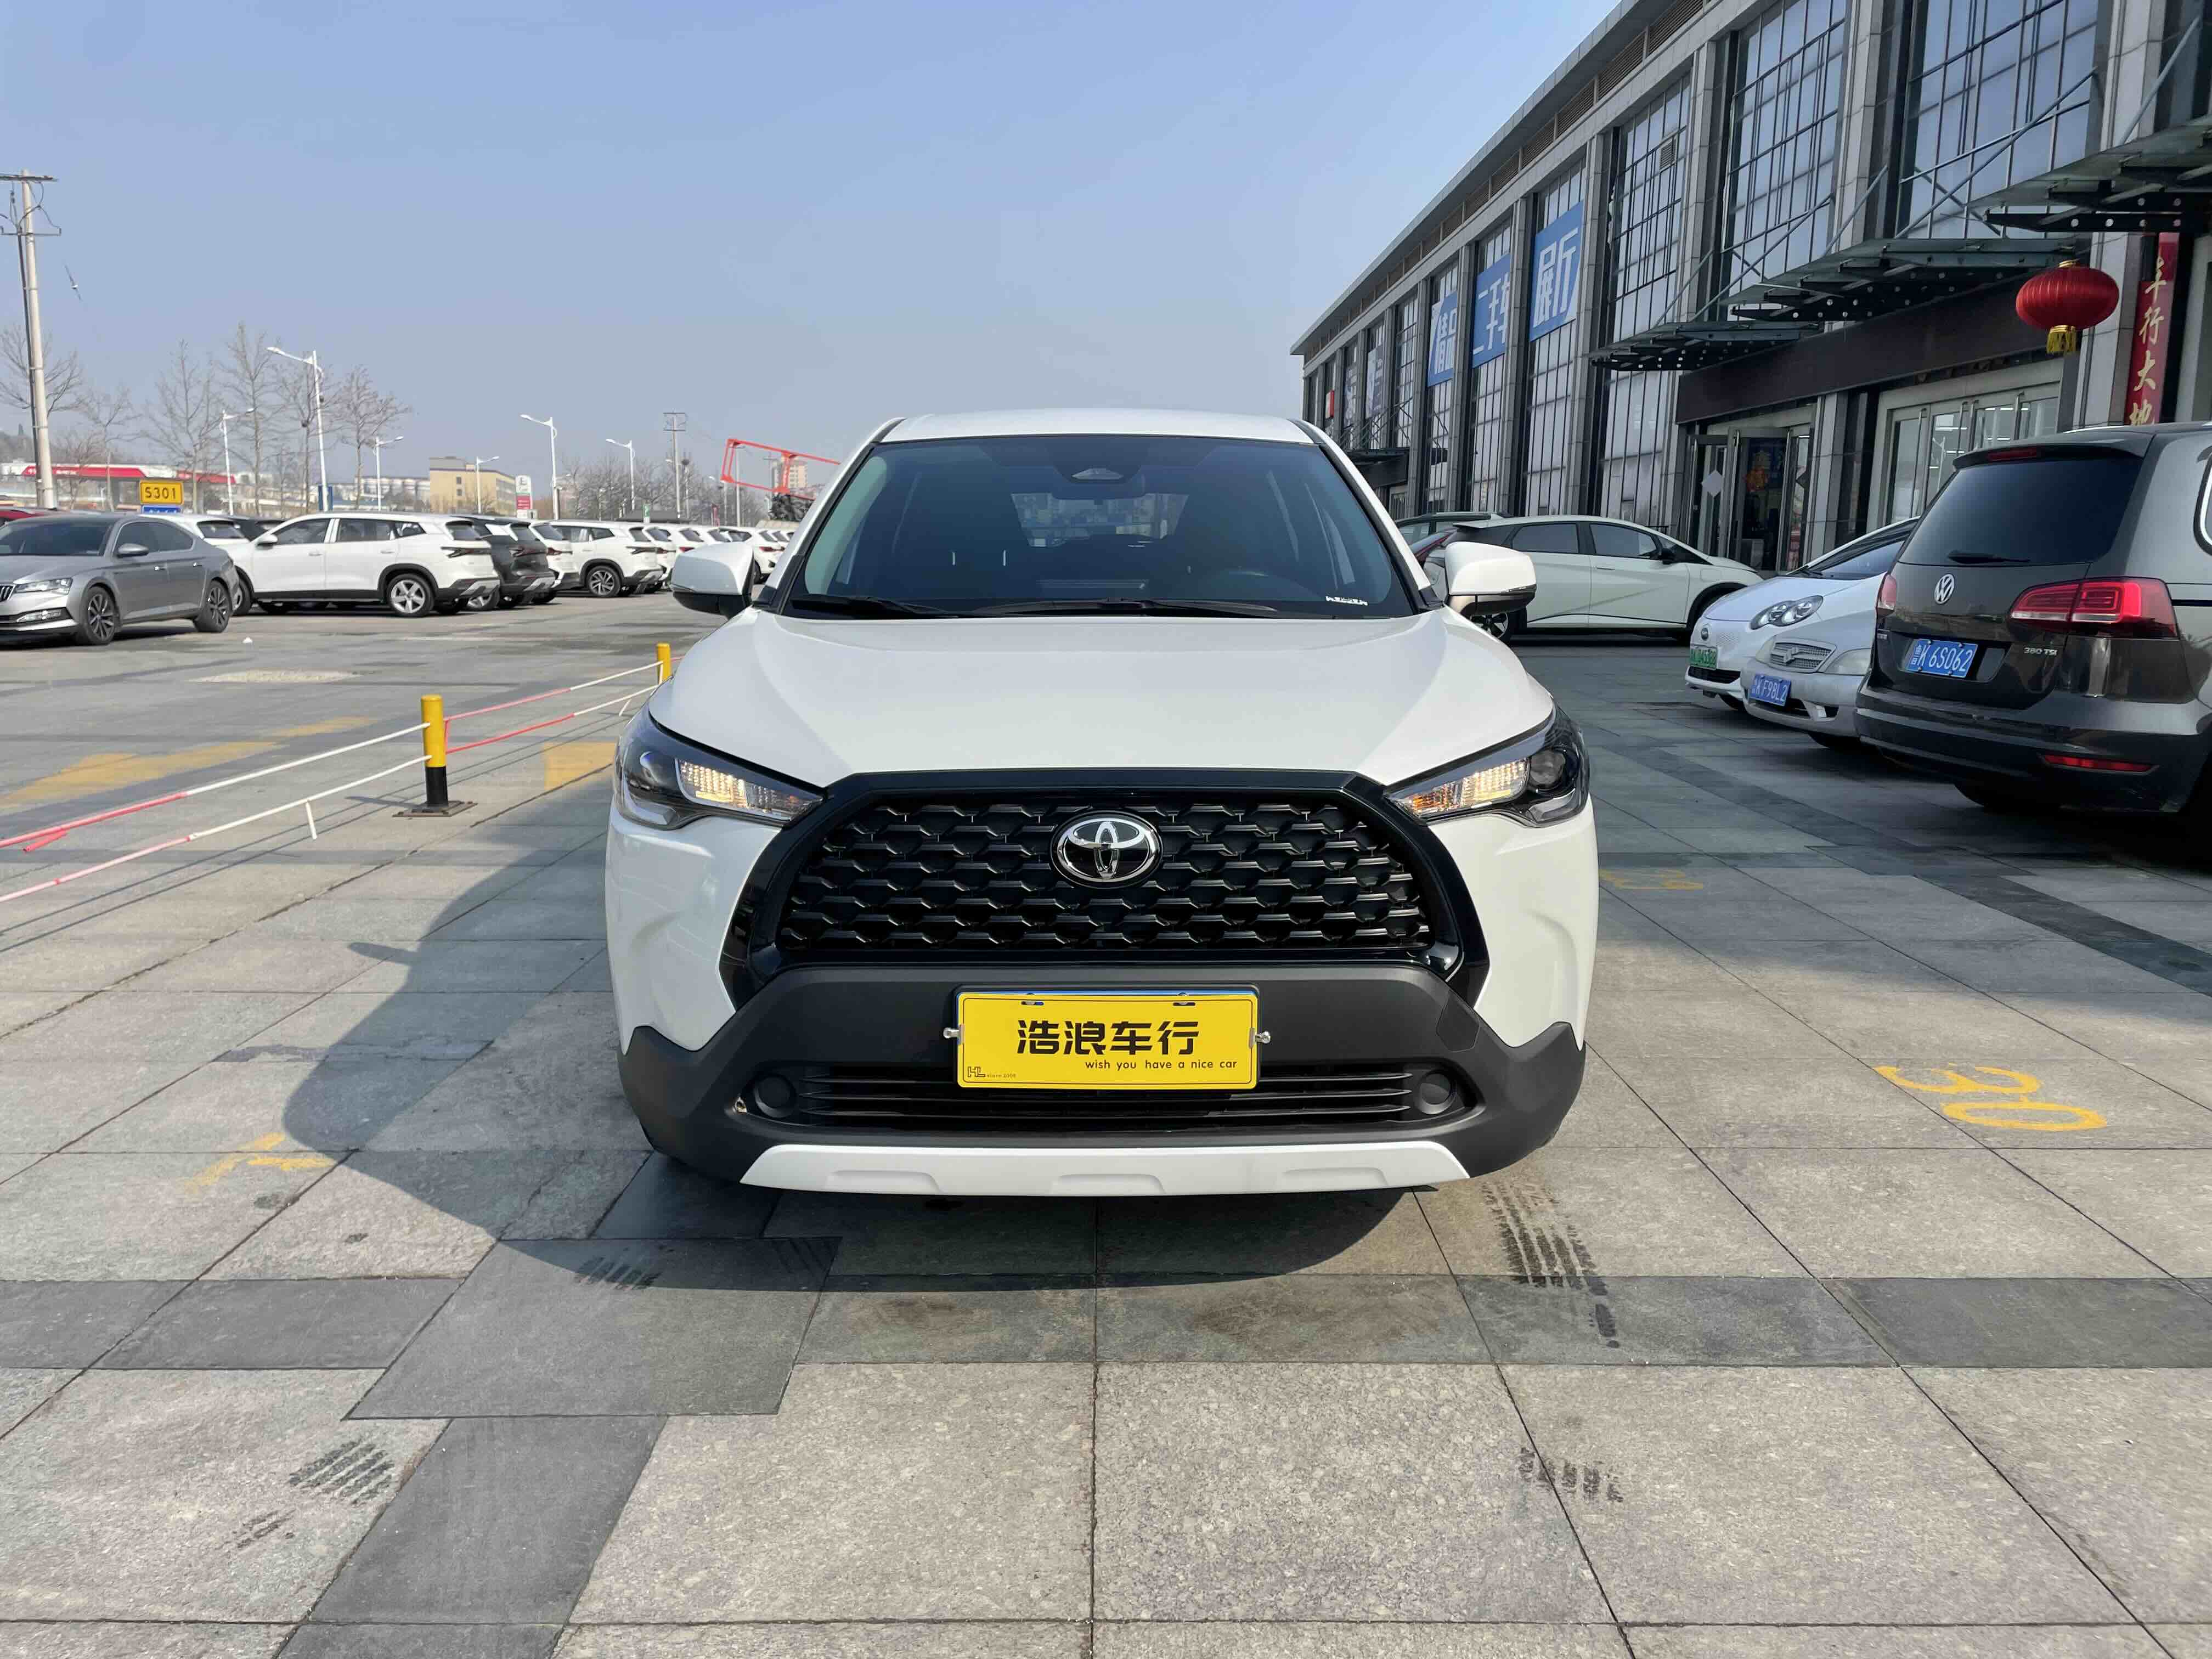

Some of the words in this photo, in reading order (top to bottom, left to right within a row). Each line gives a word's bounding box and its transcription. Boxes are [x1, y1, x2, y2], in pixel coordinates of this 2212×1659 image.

[145, 487, 176, 499] S301
[1017, 1019, 1200, 1056] 浩浪车行
[1085, 1059, 1111, 1069] wish
[1116, 1061, 1137, 1071] you
[1145, 1059, 1172, 1069] have
[1190, 1059, 1214, 1069] nice
[1219, 1060, 1238, 1069] car
